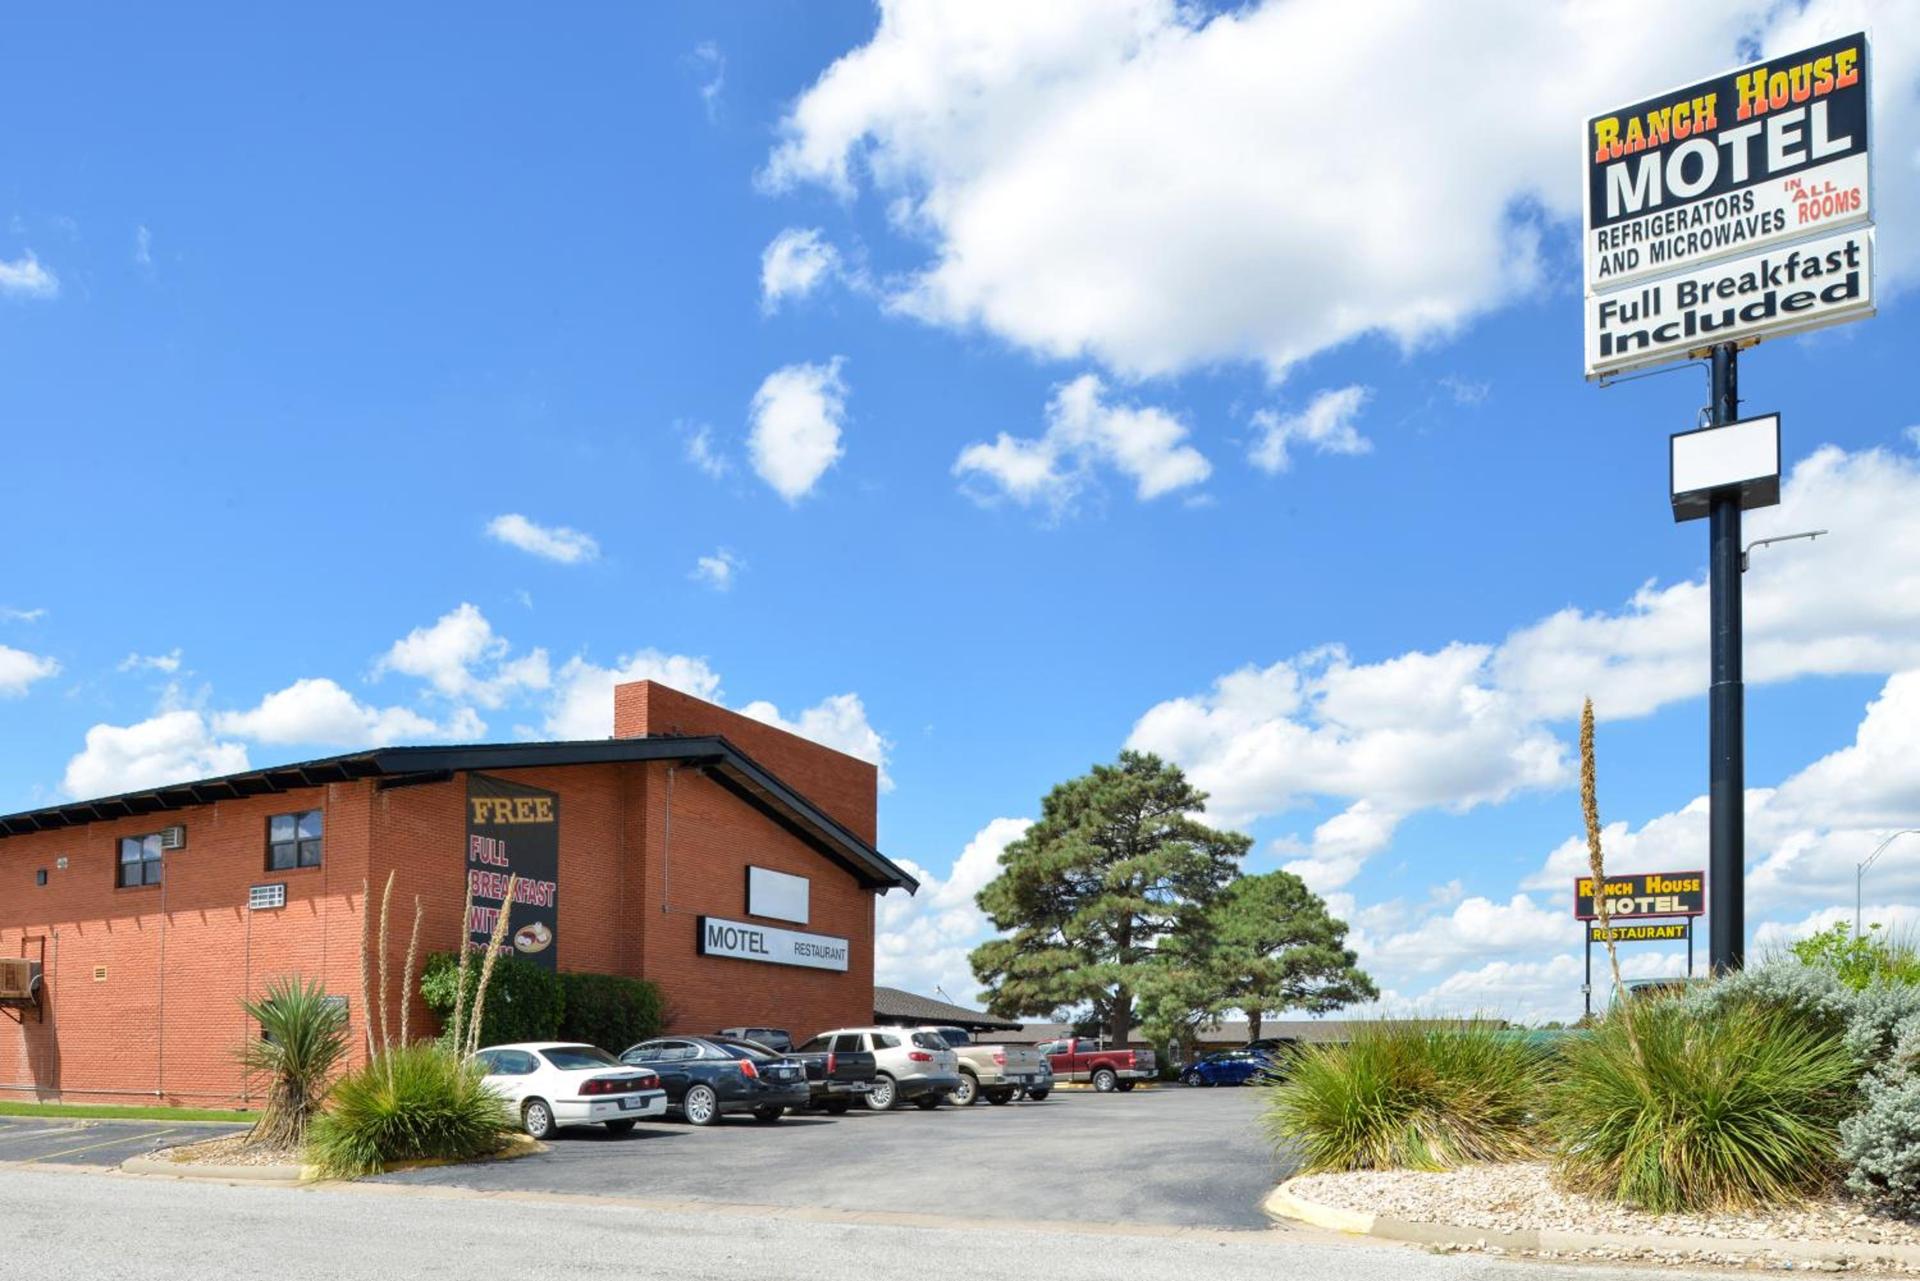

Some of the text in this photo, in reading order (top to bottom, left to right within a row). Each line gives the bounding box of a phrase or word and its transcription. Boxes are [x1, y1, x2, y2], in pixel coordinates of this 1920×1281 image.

[1594, 48, 1858, 163] RANCH HOUSE
[1606, 100, 1852, 219] MOTEL
[1784, 178, 1801, 192] IN
[1792, 181, 1837, 203] ALL
[1599, 190, 1754, 252] REFRIGERATORS
[1798, 188, 1861, 224] ROOMS
[1599, 208, 1785, 277] AND MICROWAVES
[1599, 240, 1859, 329] Full Breakfast
[1600, 271, 1859, 356] Included
[471, 797, 554, 824] FREE
[470, 834, 509, 867] FULL
[469, 869, 556, 908] BREAKFAST
[1579, 876, 1700, 897] RNCH HOUSE
[470, 906, 508, 936] WIT
[1593, 926, 1684, 940] RESTAURANT
[708, 925, 846, 961] MOTEL RESTAURANT
